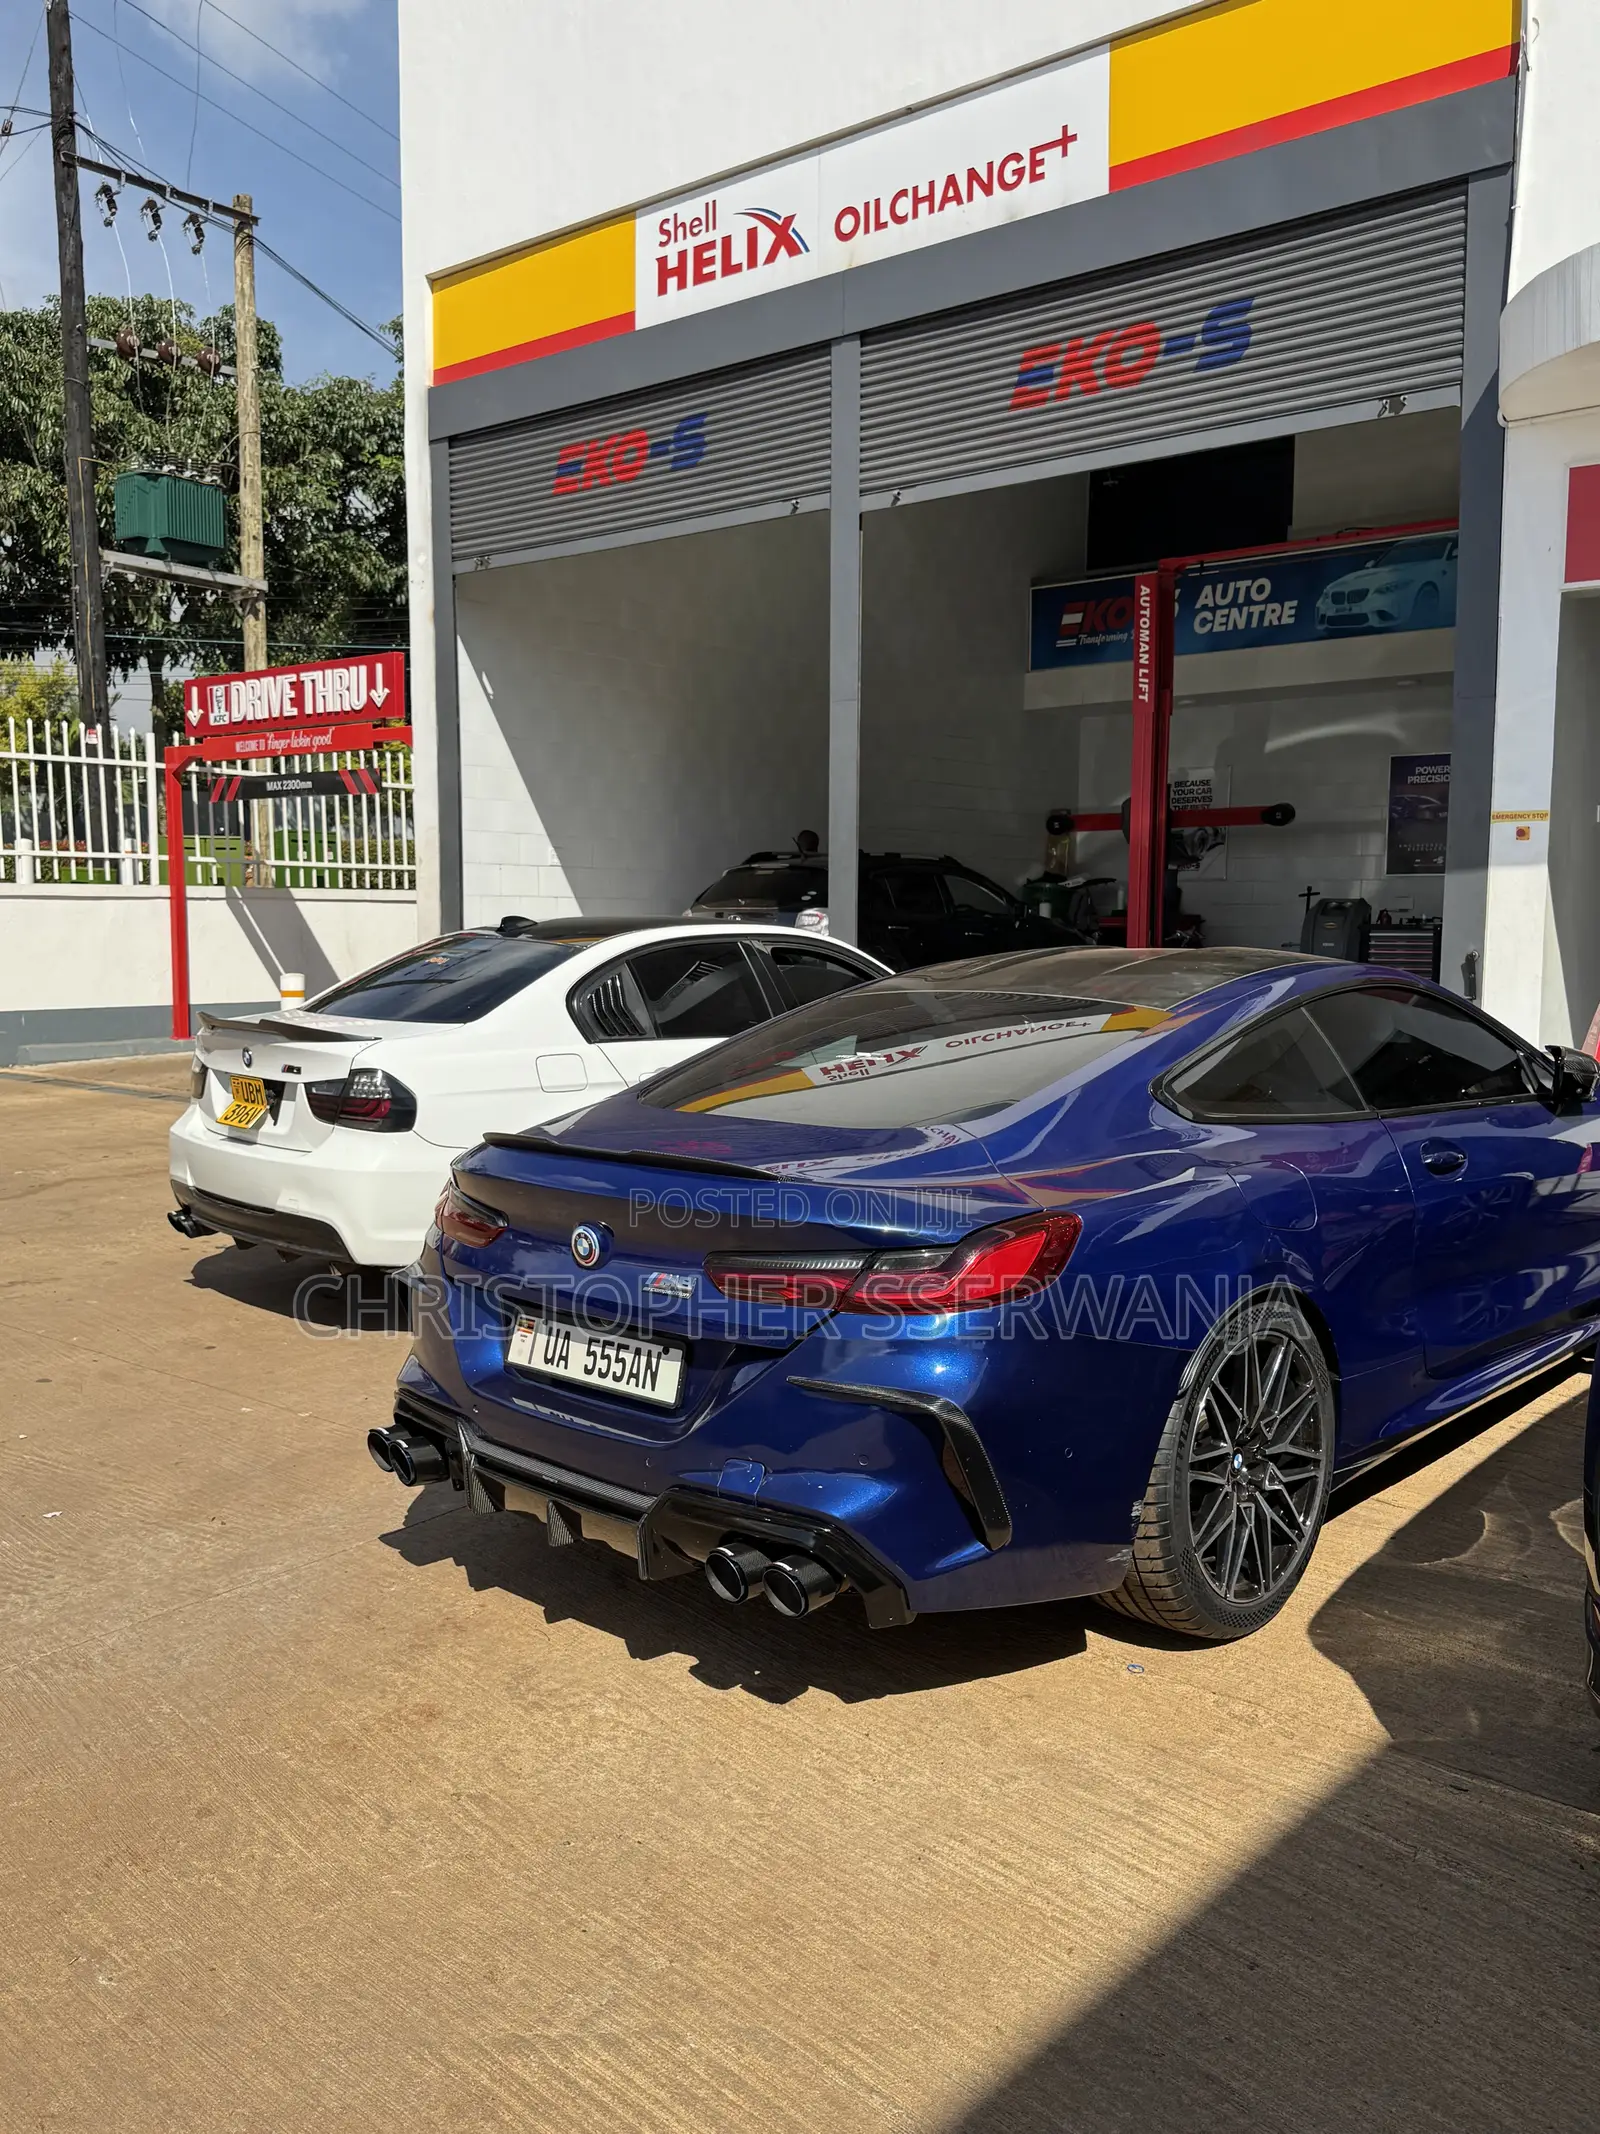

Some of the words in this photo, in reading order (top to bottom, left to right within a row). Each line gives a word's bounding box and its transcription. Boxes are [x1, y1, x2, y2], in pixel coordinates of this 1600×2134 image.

[658, 199, 717, 248] Shell
[656, 212, 801, 297] HELIX
[1009, 297, 1256, 413] EKO-S
[552, 411, 708, 497] EKO-S
[1195, 577, 1272, 608] AUTO
[1139, 585, 1151, 664] AUTOMAN
[1193, 600, 1299, 635] CENTRE
[230, 673, 299, 723] DRIVE
[300, 664, 368, 715] THRU
[1138, 668, 1149, 703] LIFT
[213, 714, 227, 723] KFC
[266, 780, 282, 791] MAX
[282, 779, 313, 790] 2300mm
[1174, 779, 1211, 788] BECAUSE
[1415, 764, 1450, 775] POWER
[1171, 795, 1213, 804] DESERVES
[1172, 788, 1194, 797] YOUR
[1195, 787, 1212, 795] CAR
[1492, 812, 1530, 820] EMERGENCY
[1531, 812, 1549, 820] STOP
[241, 1081, 265, 1106] UBH
[224, 1104, 263, 1125] 396V
[542, 1321, 569, 1371] UA
[583, 1335, 663, 1393] 555AN
